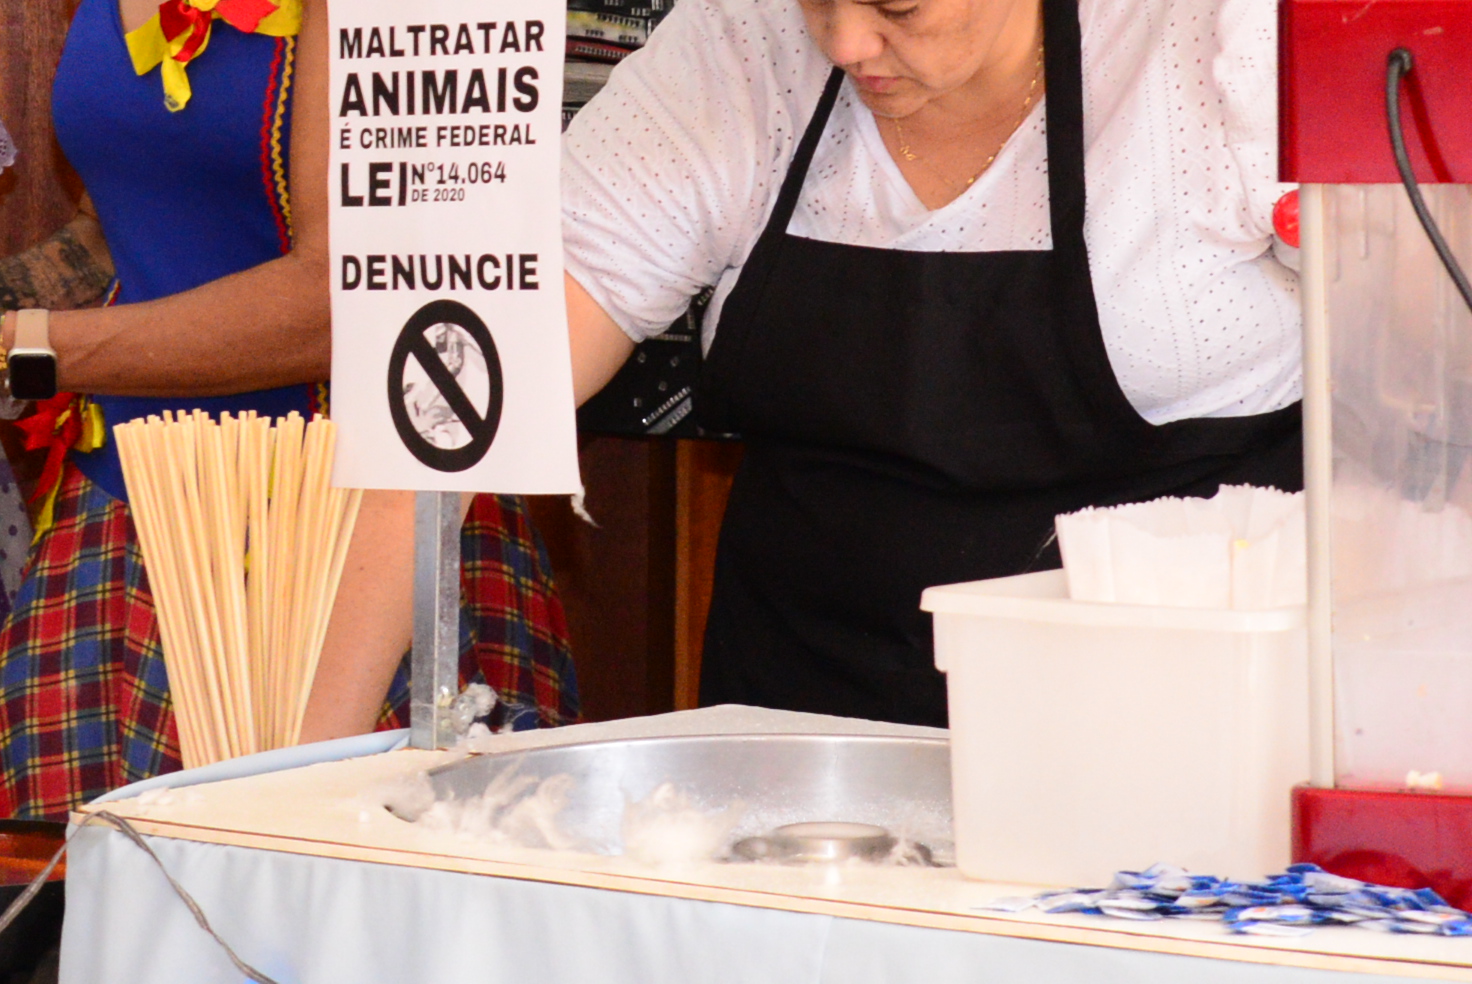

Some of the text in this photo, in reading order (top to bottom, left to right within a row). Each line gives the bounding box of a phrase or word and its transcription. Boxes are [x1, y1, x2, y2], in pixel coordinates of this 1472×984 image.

[339, 20, 545, 59] MALTRATAR
[338, 65, 540, 117] ANIMAIS
[339, 121, 537, 149] É CRIME FEDERAL
[340, 161, 407, 207] LEI
[410, 187, 466, 203] DE 2020
[340, 253, 540, 291] DENUNCIE
